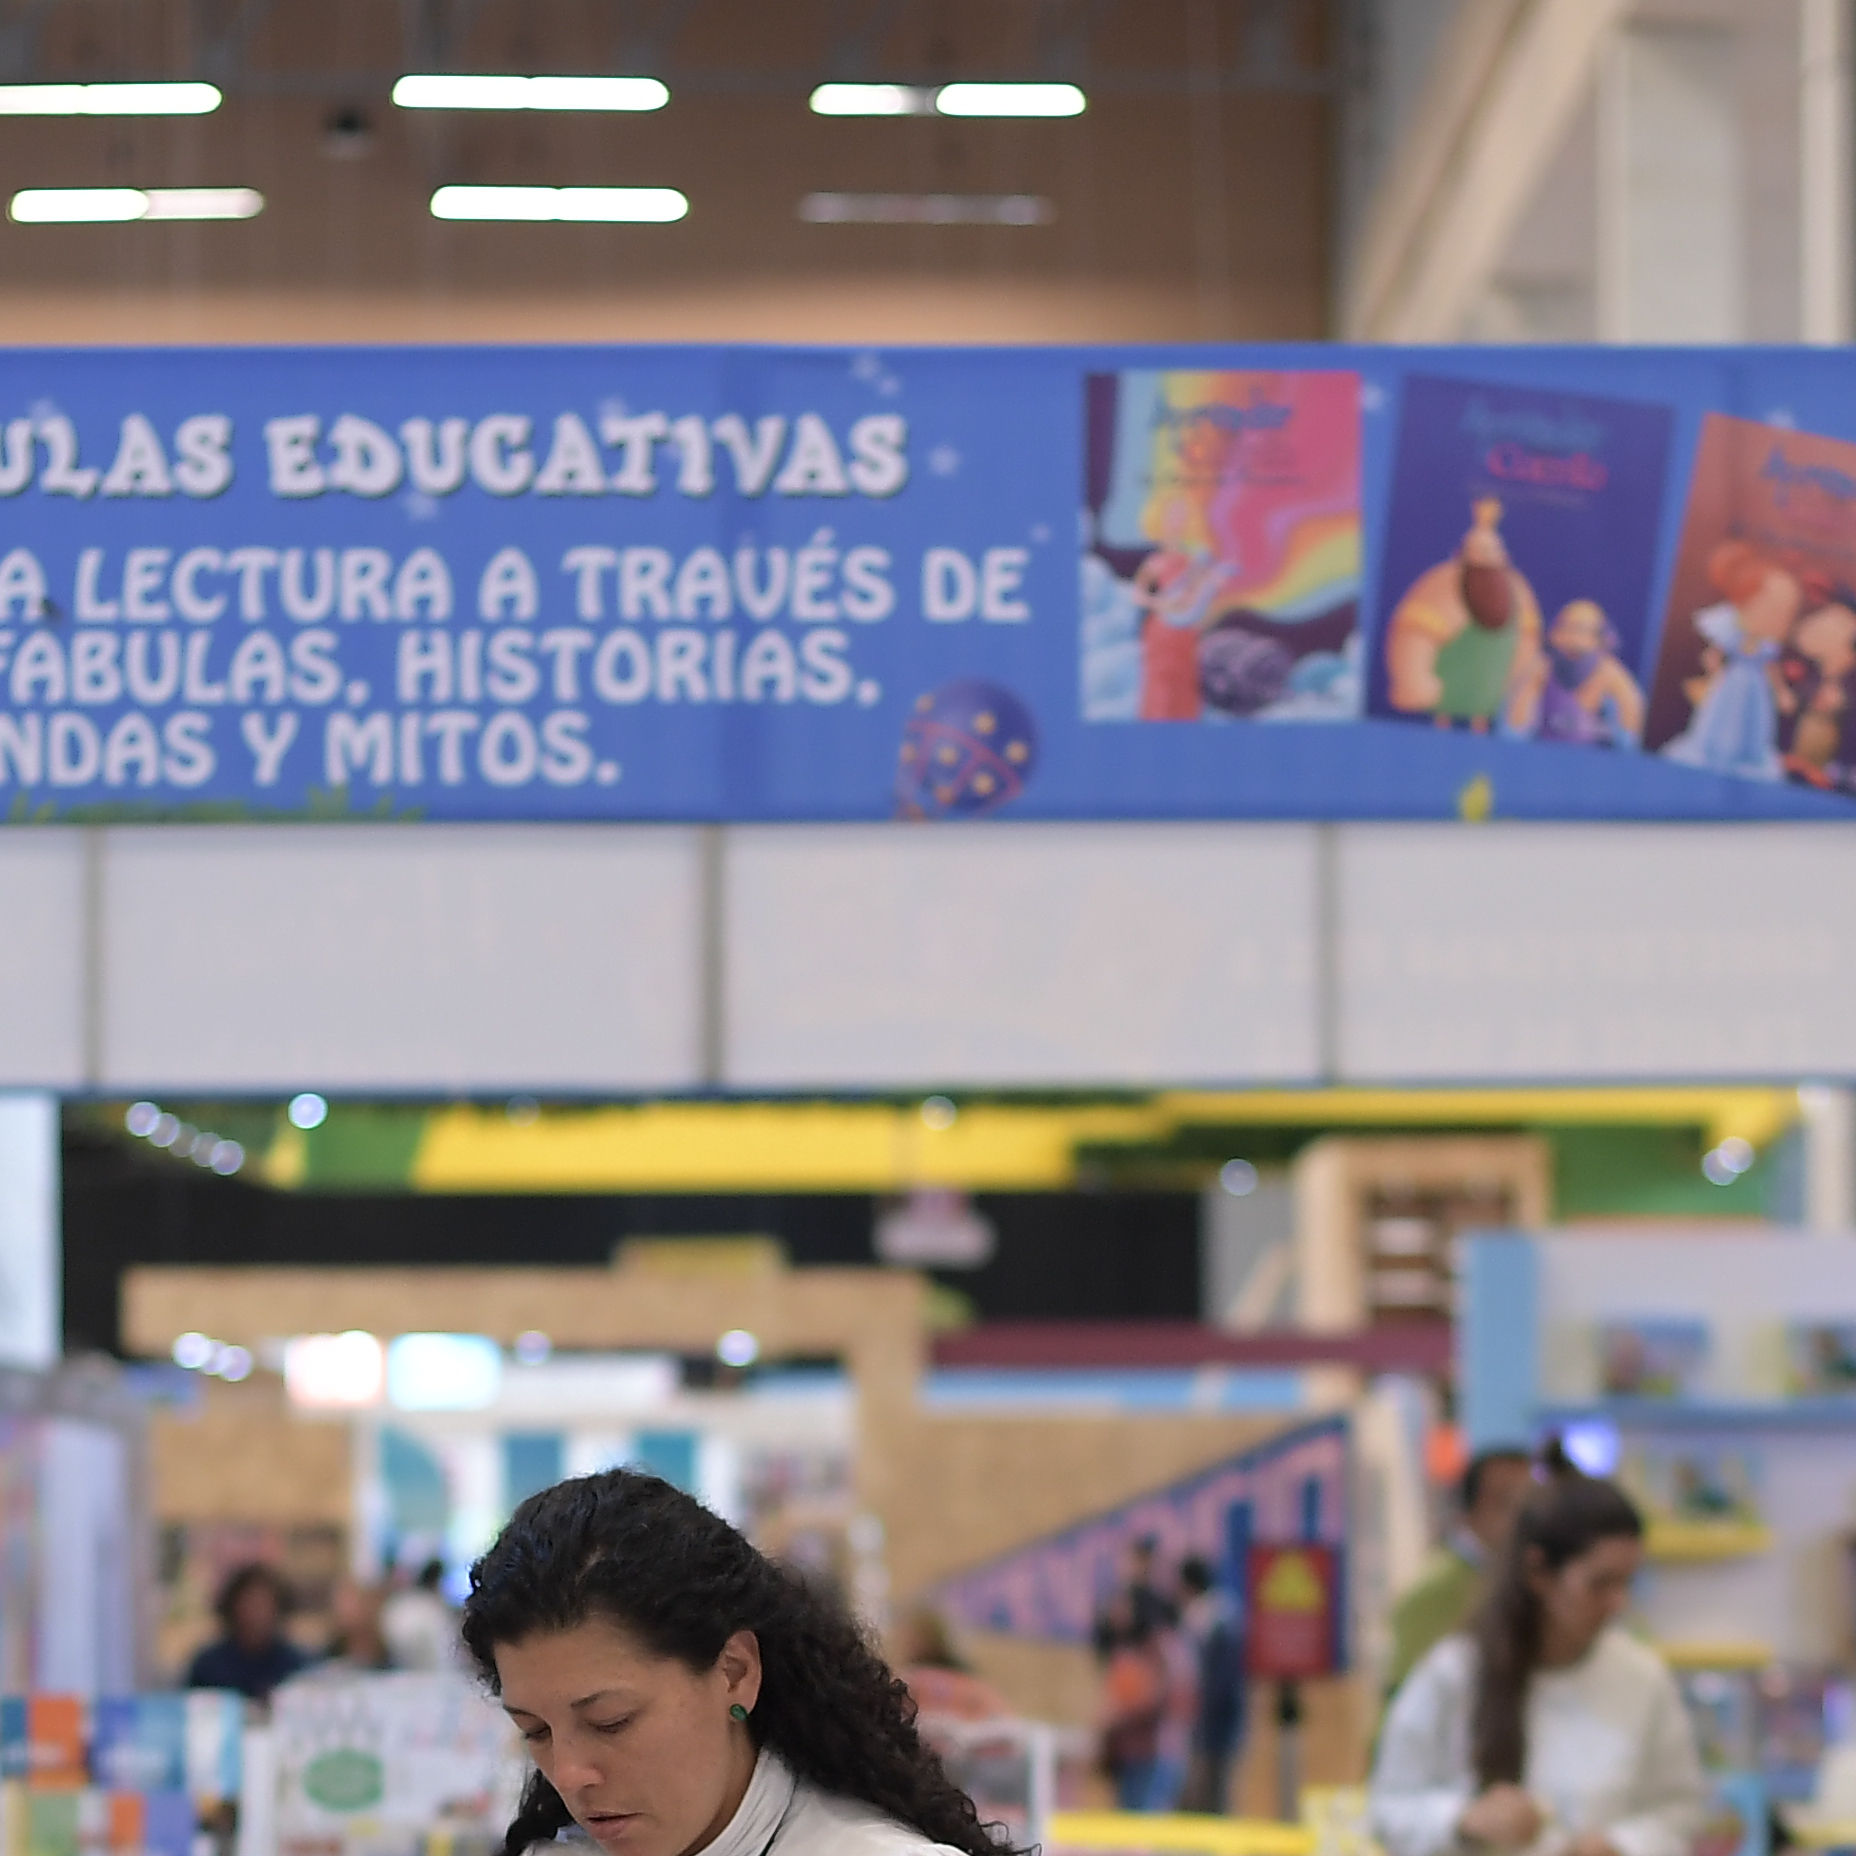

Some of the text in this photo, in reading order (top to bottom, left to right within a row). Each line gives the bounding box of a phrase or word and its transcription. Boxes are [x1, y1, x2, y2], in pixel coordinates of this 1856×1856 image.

[264, 412, 909, 499] EDUCATIVAS
[74, 547, 453, 623] LECTURA
[478, 546, 540, 621] A
[562, 526, 897, 622] TRAVÉS
[921, 547, 1033, 623] DE
[242, 711, 300, 786] Y
[323, 710, 623, 786] MITOS.
